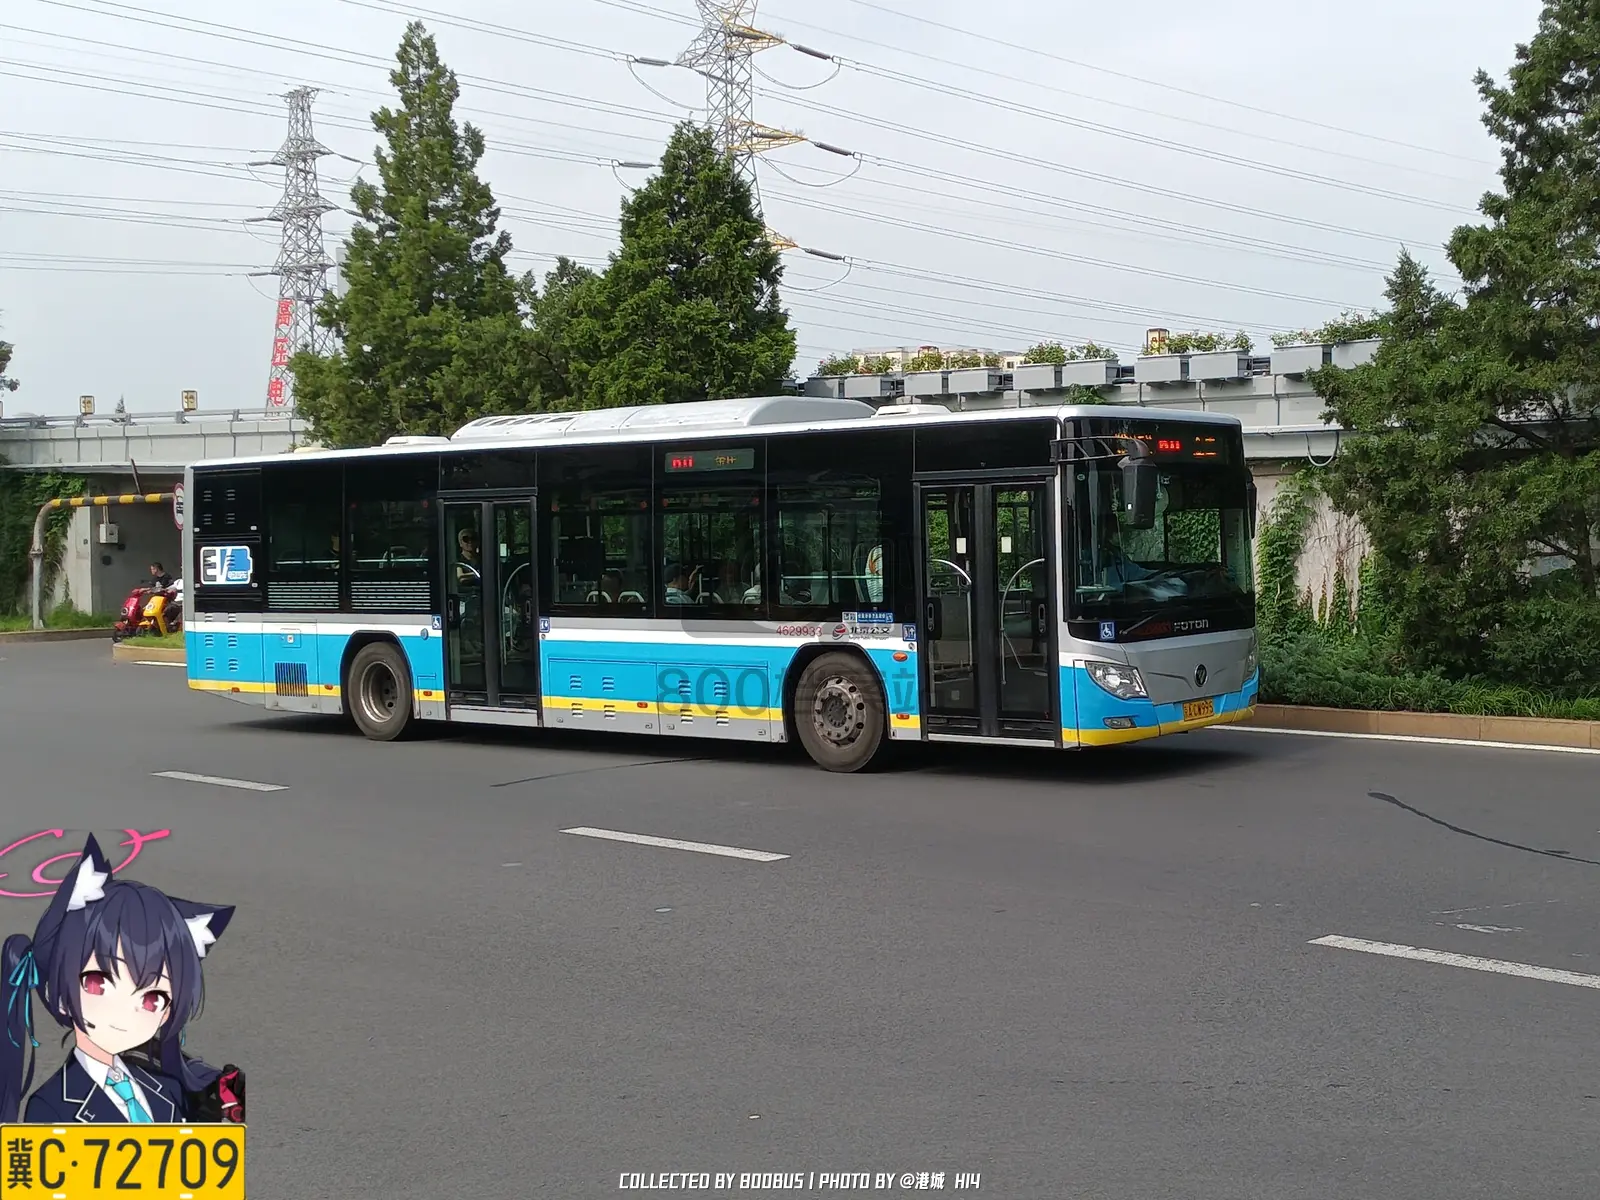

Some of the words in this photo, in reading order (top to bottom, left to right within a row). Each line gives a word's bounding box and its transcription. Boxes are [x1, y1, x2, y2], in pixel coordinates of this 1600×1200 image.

[776, 625, 823, 637] 4629933
[849, 626, 891, 635] 北京公交
[1173, 619, 1209, 632] FOTON
